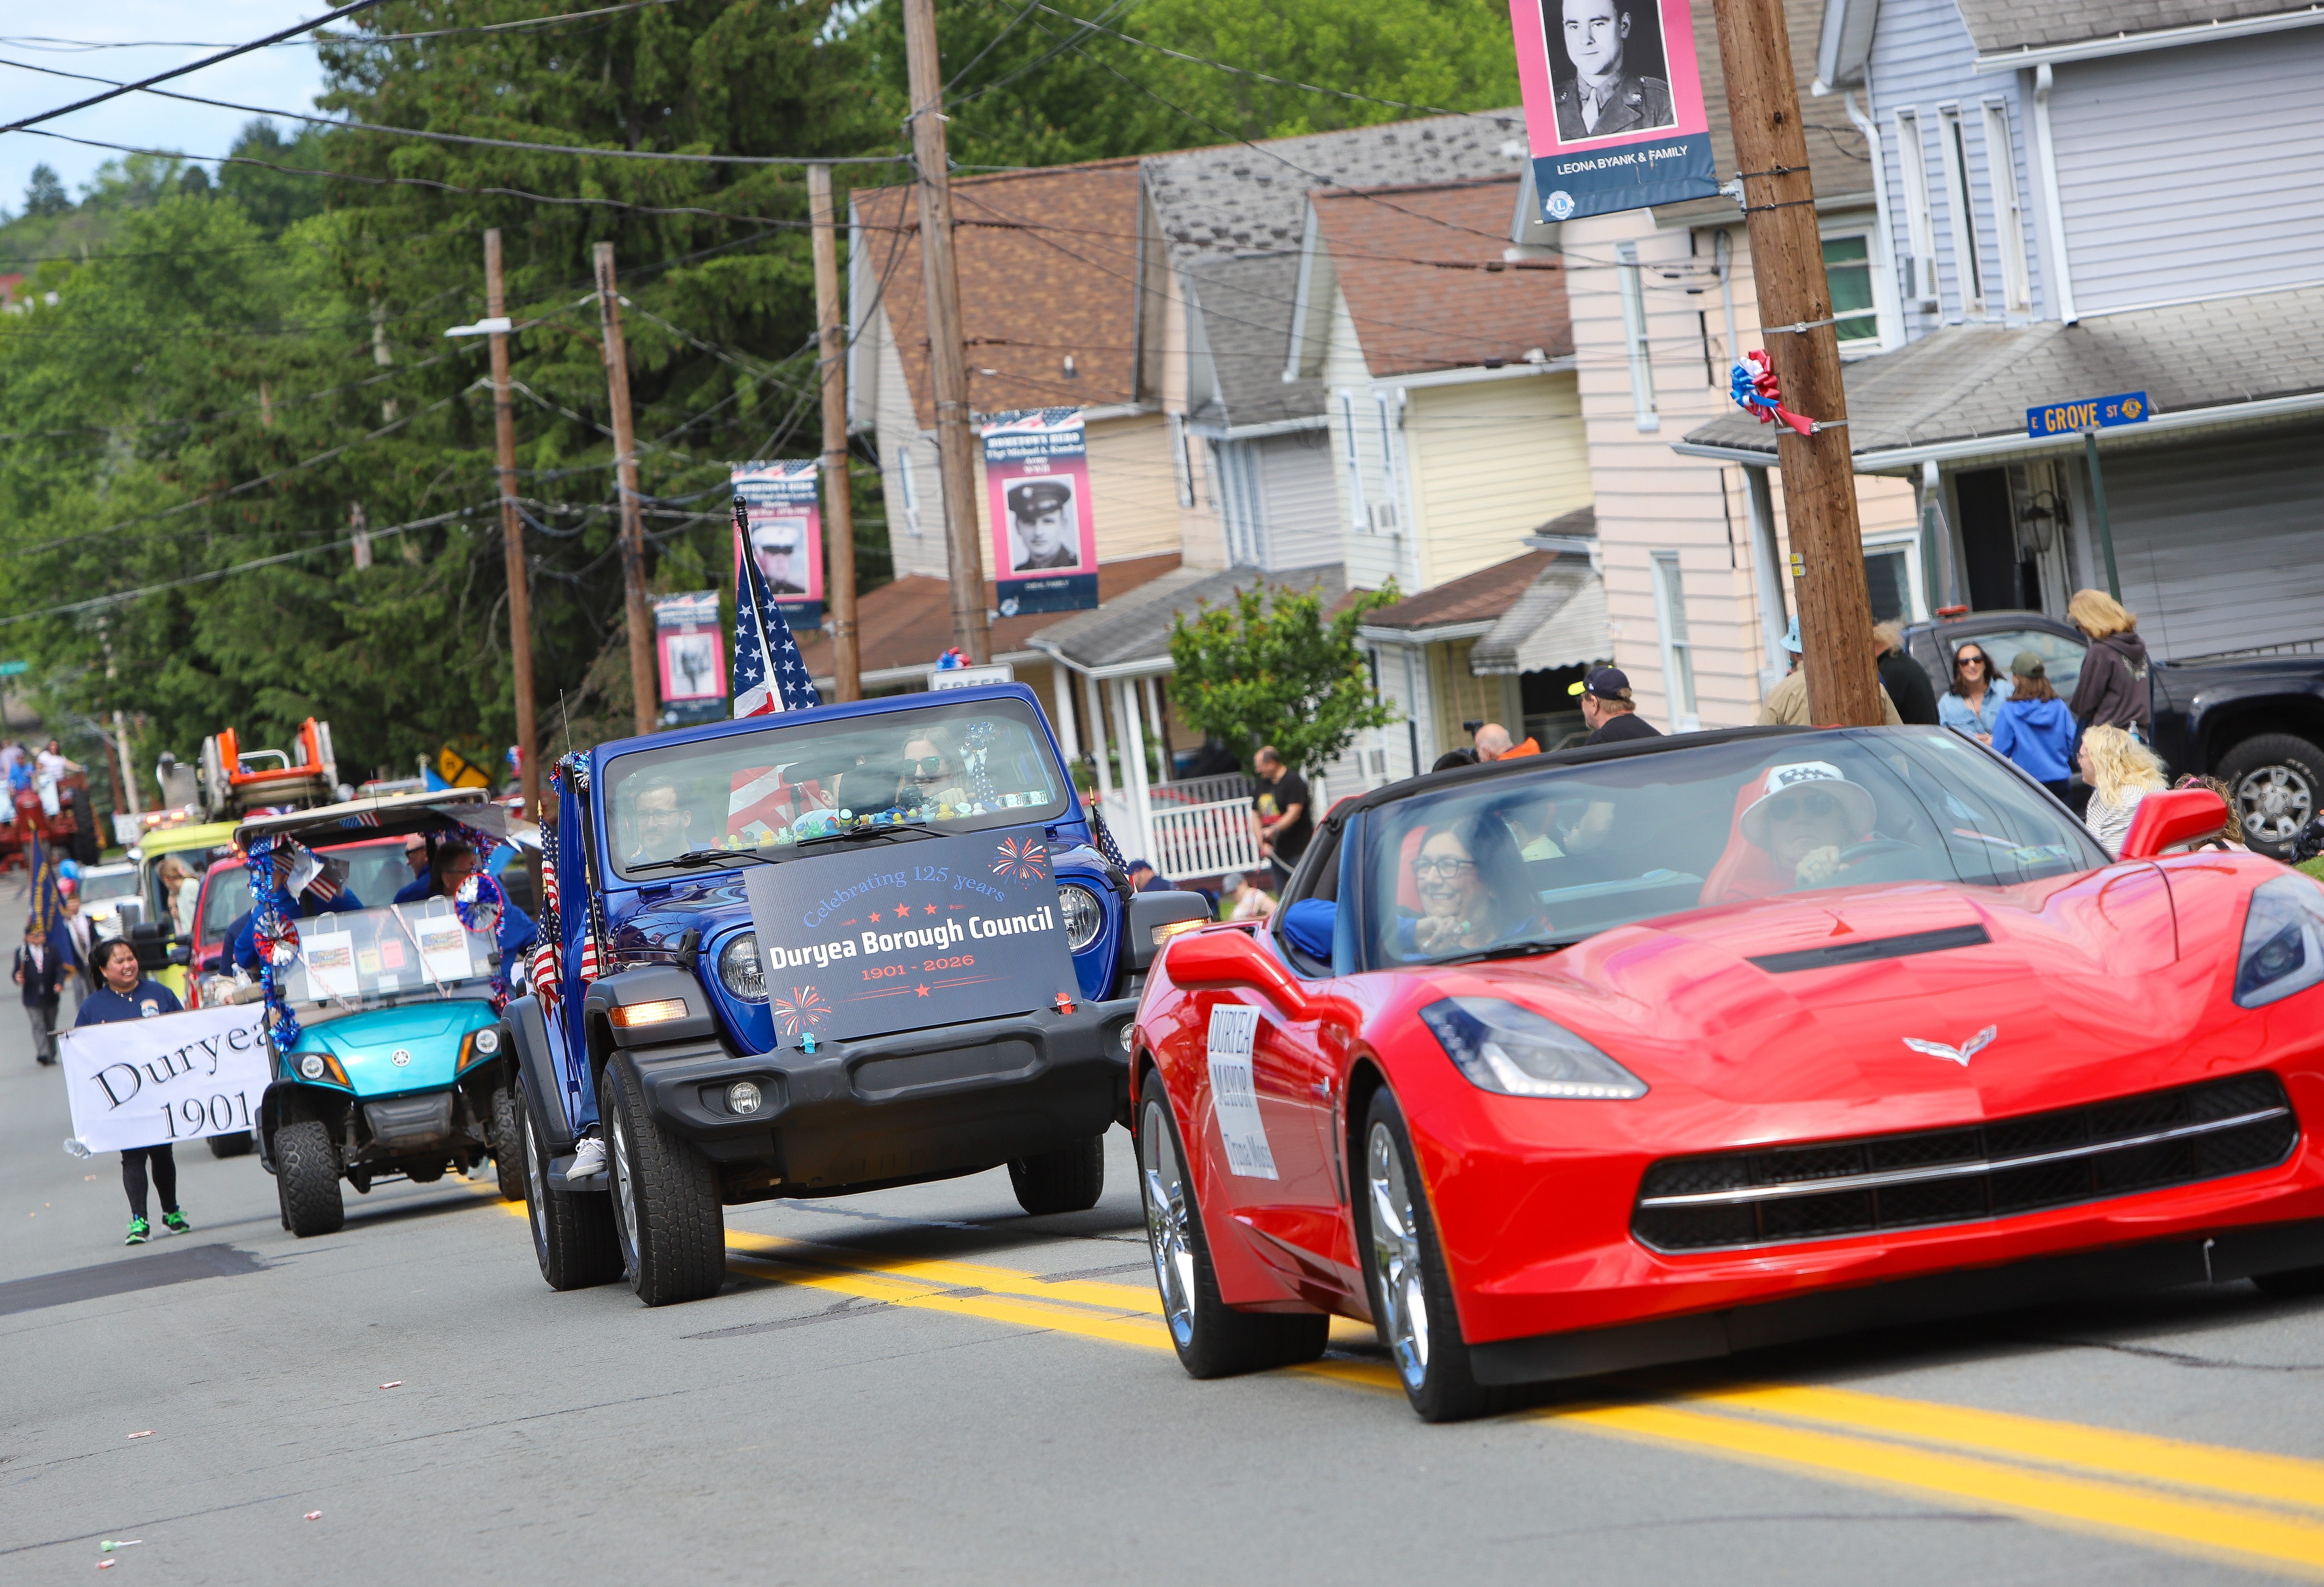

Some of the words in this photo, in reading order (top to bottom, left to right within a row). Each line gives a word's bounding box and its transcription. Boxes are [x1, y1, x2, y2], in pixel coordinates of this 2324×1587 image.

[1557, 160, 1598, 175] LEONA
[1597, 153, 1637, 169] BYANK
[1637, 152, 1647, 162] &
[1648, 145, 1688, 161] FAMILY
[2031, 417, 2039, 429] E
[2045, 402, 2100, 432] GROVE
[2106, 404, 2119, 418] ST
[988, 435, 1049, 448] HOMETOWN
[1049, 432, 1081, 444] HERO
[1023, 464, 1050, 474] WWII
[1002, 798, 1006, 808] 4
[1015, 795, 1022, 805] 27
[1026, 795, 1030, 804] 4
[1039, 792, 1046, 803] 27
[803, 871, 908, 928] Celebrating
[913, 865, 949, 882] 125
[952, 874, 1006, 902] years
[769, 939, 858, 970] Duryea
[860, 917, 965, 955] Borough
[968, 905, 1055, 939] Council
[862, 964, 907, 981] 1901
[923, 954, 975, 972] 2026
[1210, 1010, 1254, 1054] DURYEA
[90, 1022, 267, 1111] Duryea
[1213, 1064, 1252, 1108] MAYOR
[160, 1090, 254, 1139] 1901
